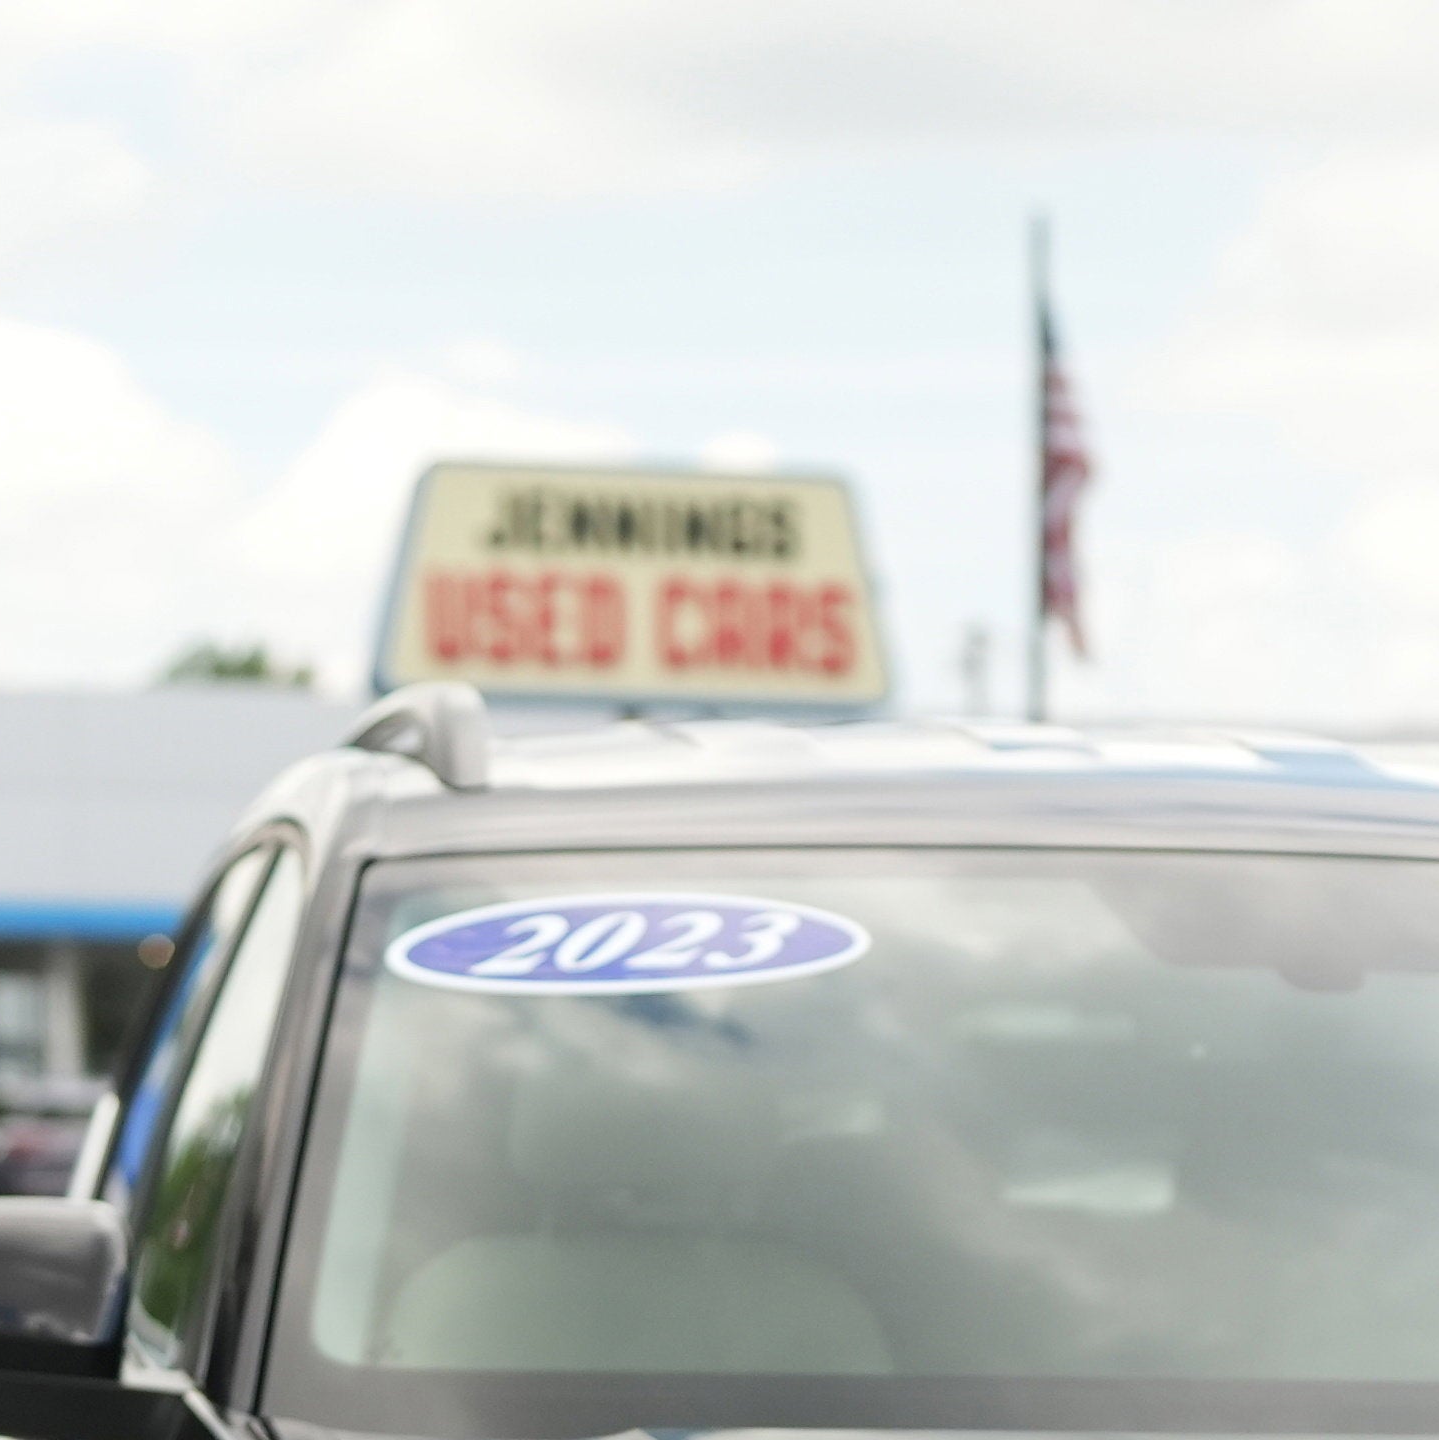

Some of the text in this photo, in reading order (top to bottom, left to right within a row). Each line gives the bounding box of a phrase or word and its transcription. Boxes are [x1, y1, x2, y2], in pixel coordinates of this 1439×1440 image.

[484, 488, 797, 558] JENNINGS
[424, 565, 855, 677] USED CARS
[469, 908, 801, 976] 2023
